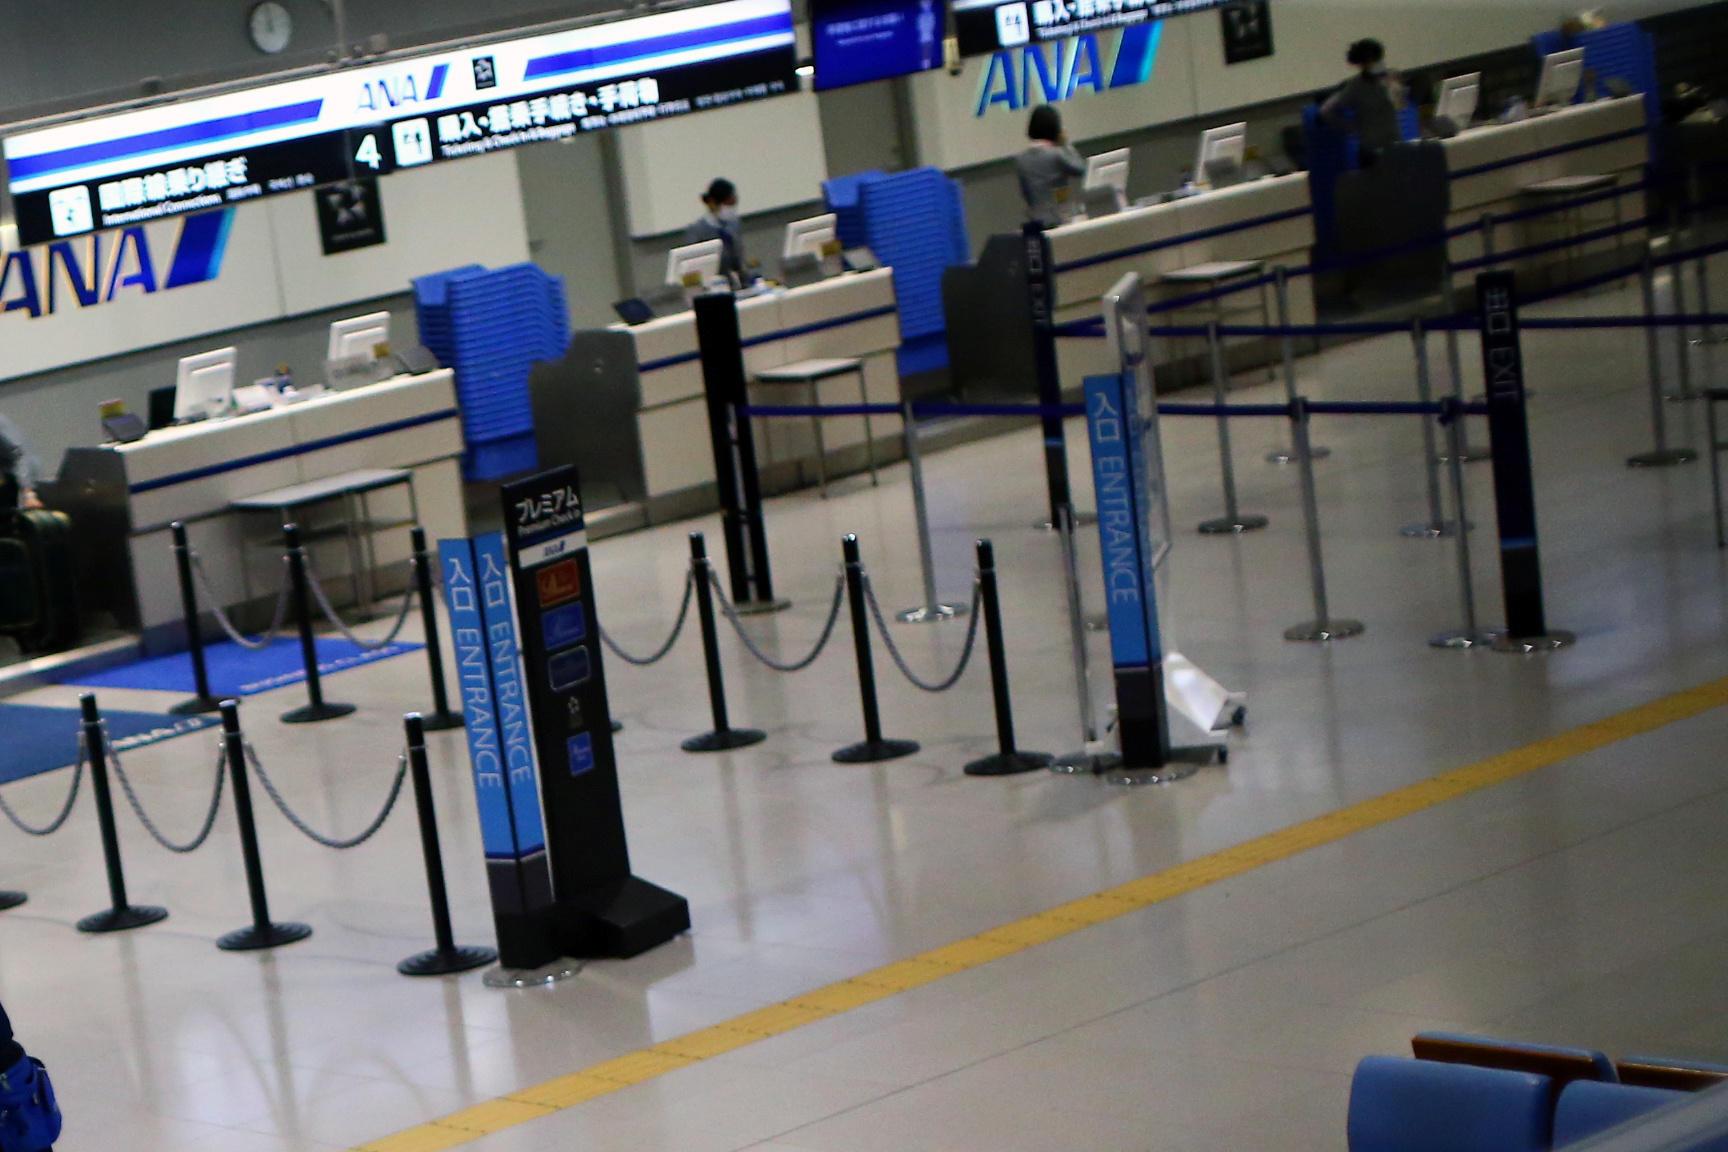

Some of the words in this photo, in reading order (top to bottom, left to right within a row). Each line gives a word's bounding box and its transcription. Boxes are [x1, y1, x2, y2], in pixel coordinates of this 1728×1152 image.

[356, 75, 419, 114] ANA
[976, 34, 1104, 117] ANA
[355, 133, 383, 169] 4
[1094, 392, 1121, 443] 入口
[515, 485, 580, 524] プレミアム
[1099, 456, 1139, 604] ENTRANCE
[449, 557, 475, 612] 入口
[482, 552, 506, 608] 入口
[456, 628, 503, 788] ENTRANCE
[490, 621, 532, 785] ENTRANCE
